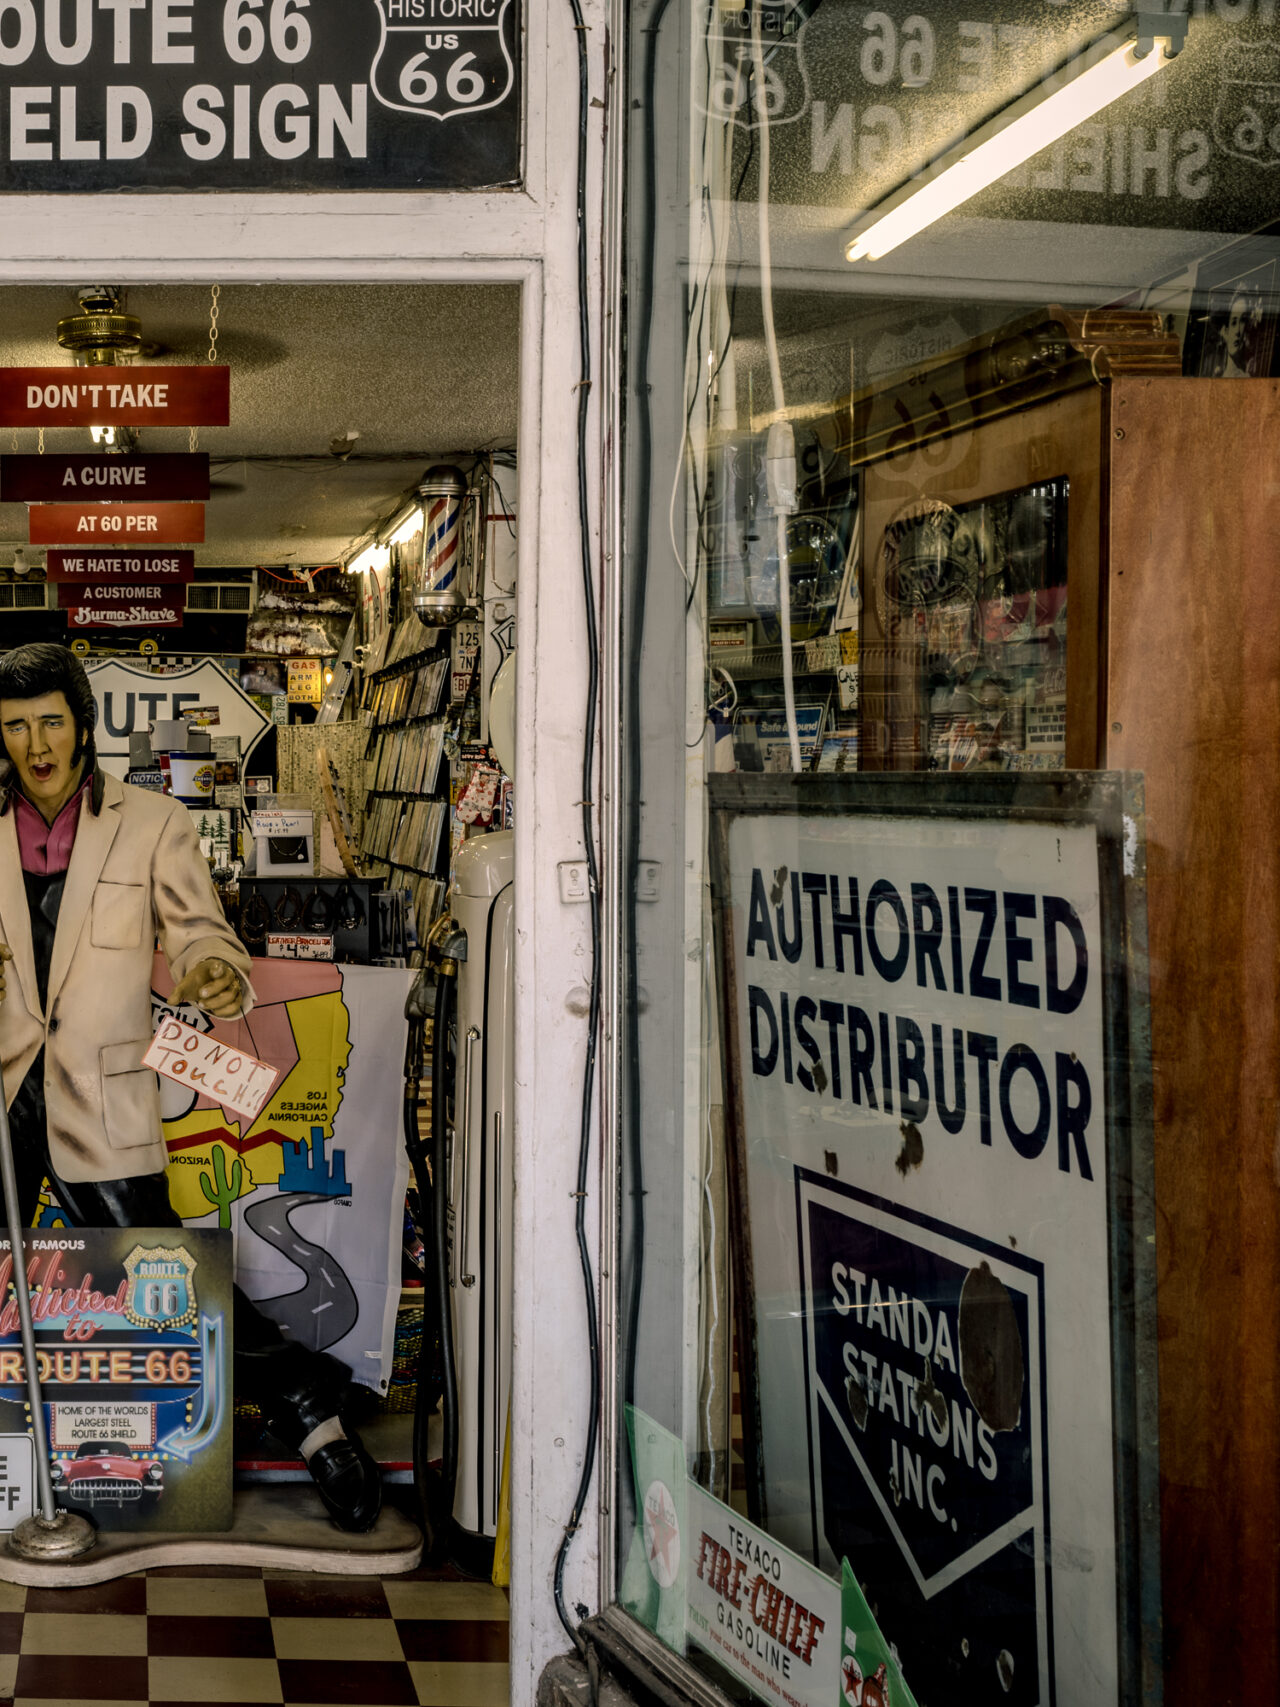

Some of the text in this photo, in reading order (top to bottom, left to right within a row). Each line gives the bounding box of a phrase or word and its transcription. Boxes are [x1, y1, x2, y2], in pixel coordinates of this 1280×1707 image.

[387, 0, 496, 19] HISTORIC
[222, 0, 314, 65] 66
[424, 34, 460, 51] US
[397, 52, 486, 105] 66
[180, 83, 369, 162] SIGN
[27, 384, 169, 409] DON'T TAKE
[62, 466, 147, 486] A CURVE
[77, 515, 158, 532] AT 60 PER
[63, 559, 180, 573] WE HATE TO LOSE
[83, 586, 162, 599] A CUSTOMER
[73, 606, 178, 625] Burma-Shave
[459, 632, 479, 647] 125
[291, 661, 316, 670] GAS
[95, 692, 200, 738] UTE
[760, 722, 781, 733] Safe
[746, 867, 1089, 1015] AUTHORIZED
[161, 1022, 266, 1083] DO NOT
[747, 984, 1095, 1183] DISTRIBUTOR
[32, 1239, 86, 1251] FAMOUS
[139, 1262, 182, 1275] ROUTE
[143, 1282, 178, 1317] 66
[63, 1309, 104, 1341] to
[832, 1261, 957, 1375] STANDA
[145, 1350, 192, 1384] 66
[58, 1406, 149, 1415] HOME OF THE WORLDS
[74, 1418, 132, 1427] LARGEST STEEL
[71, 1429, 137, 1439] ROUTE 66 SHIELD
[888, 1437, 959, 1533] INC.
[728, 1524, 781, 1581] TEXACO
[693, 1530, 825, 1667] FIRE-CHIEF
[688, 1603, 710, 1633] TRUST
[740, 1651, 750, 1671] the
[751, 1663, 765, 1684] man
[767, 1675, 781, 1696] who
[717, 1601, 791, 1681] GASOLINE
